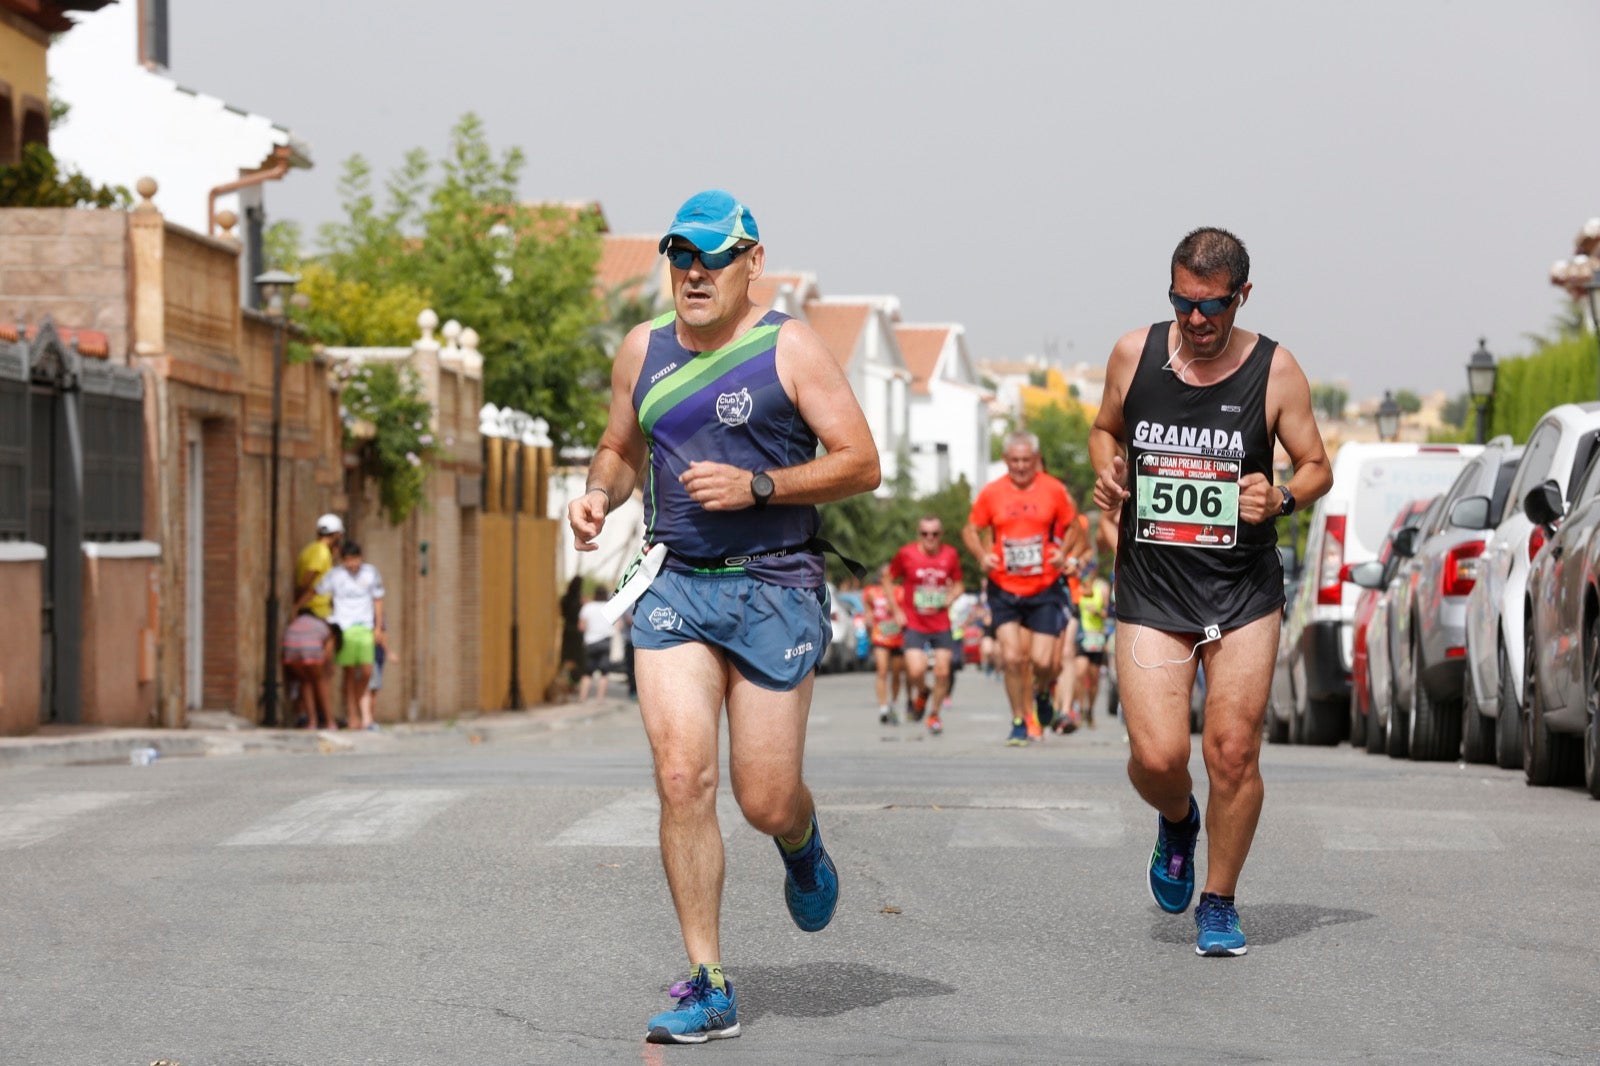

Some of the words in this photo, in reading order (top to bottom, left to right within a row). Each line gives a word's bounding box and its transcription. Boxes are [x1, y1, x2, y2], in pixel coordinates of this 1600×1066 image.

[650, 362, 677, 384] Joma
[719, 397, 736, 405] Club
[1134, 420, 1244, 451] GRANADA
[1200, 447, 1215, 456] RUN
[1216, 449, 1246, 459] PROJECT
[1160, 456, 1178, 468] GRAN
[1178, 457, 1203, 470] PREMIO
[1203, 460, 1212, 470] DE
[1151, 482, 1222, 518] 506
[784, 641, 813, 660] Joma
